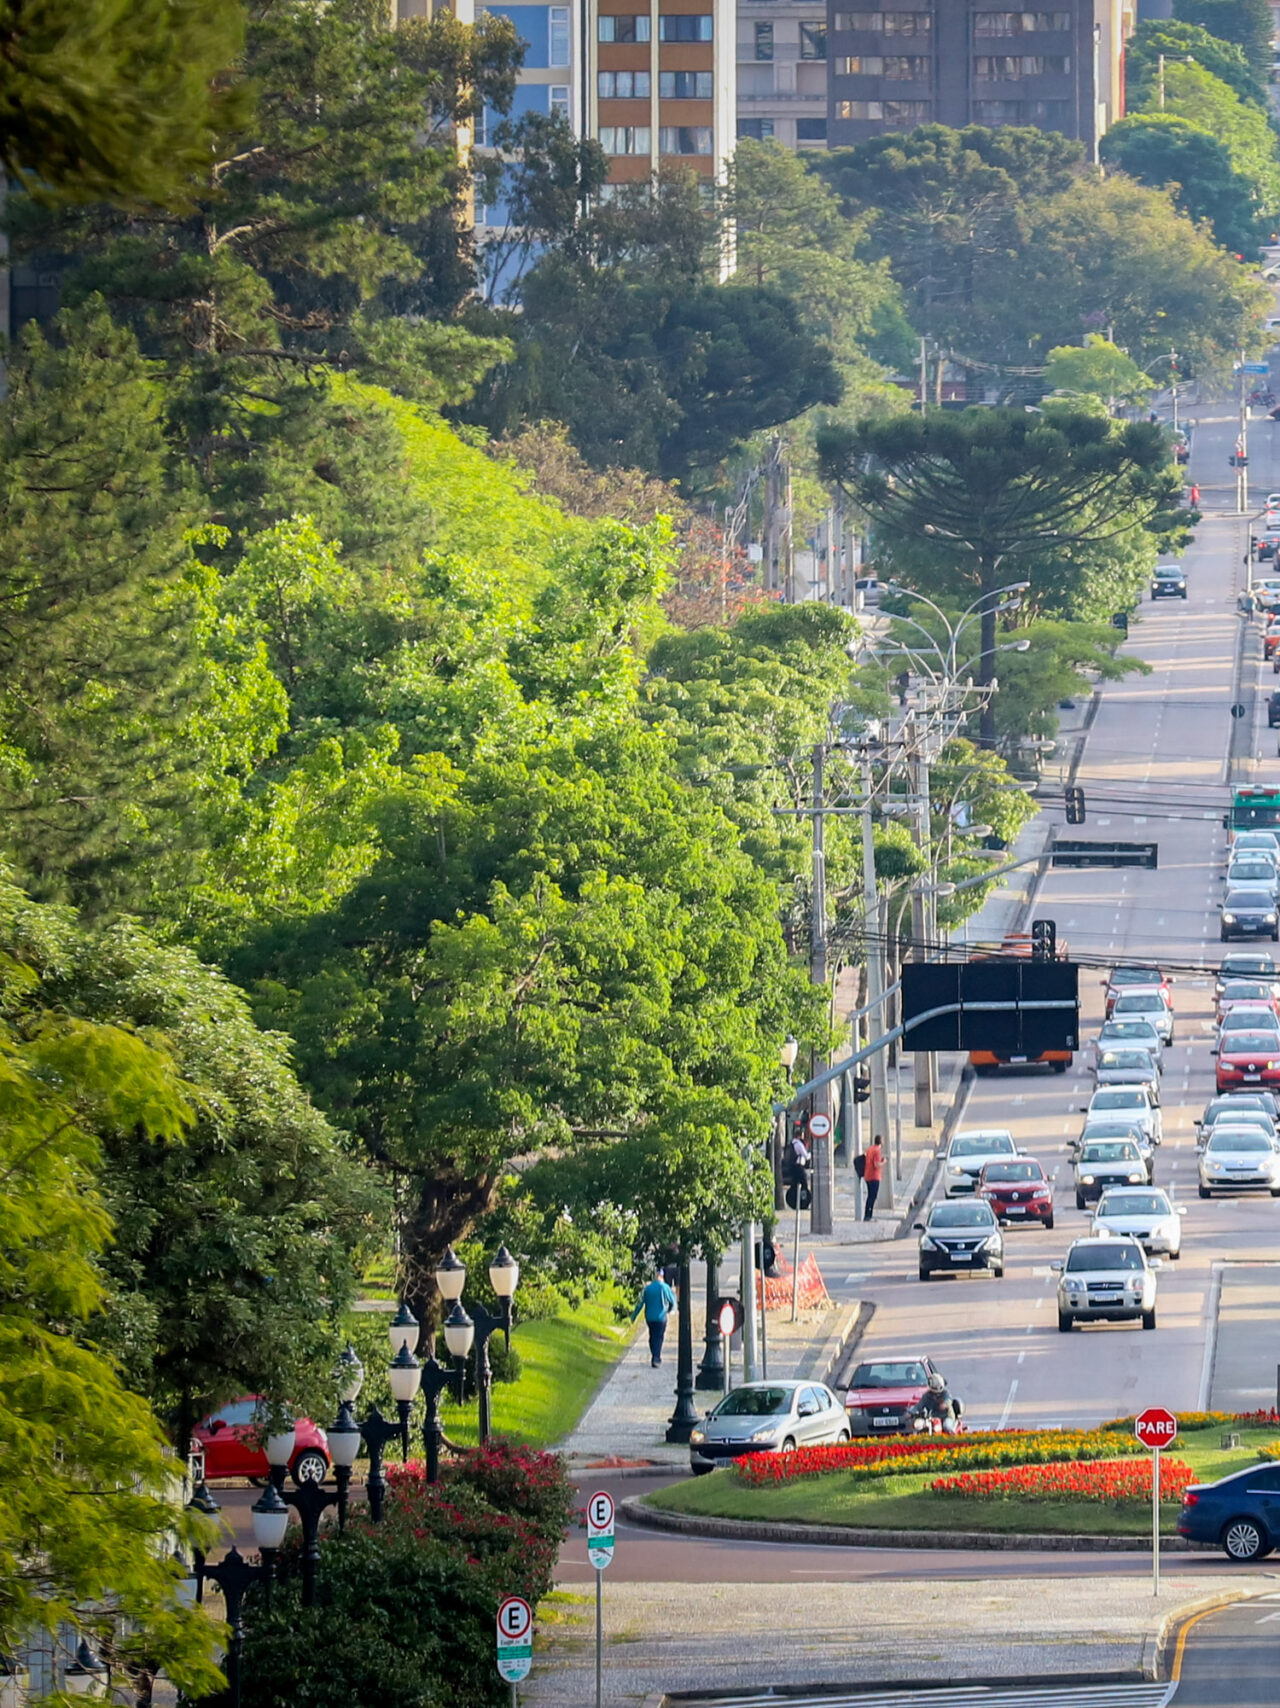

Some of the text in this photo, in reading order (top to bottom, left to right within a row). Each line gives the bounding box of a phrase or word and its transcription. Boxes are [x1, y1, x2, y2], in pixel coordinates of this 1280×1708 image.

[1138, 1421, 1174, 1434] PARE
[596, 1500, 605, 1521] E
[508, 1607, 520, 1630] E
